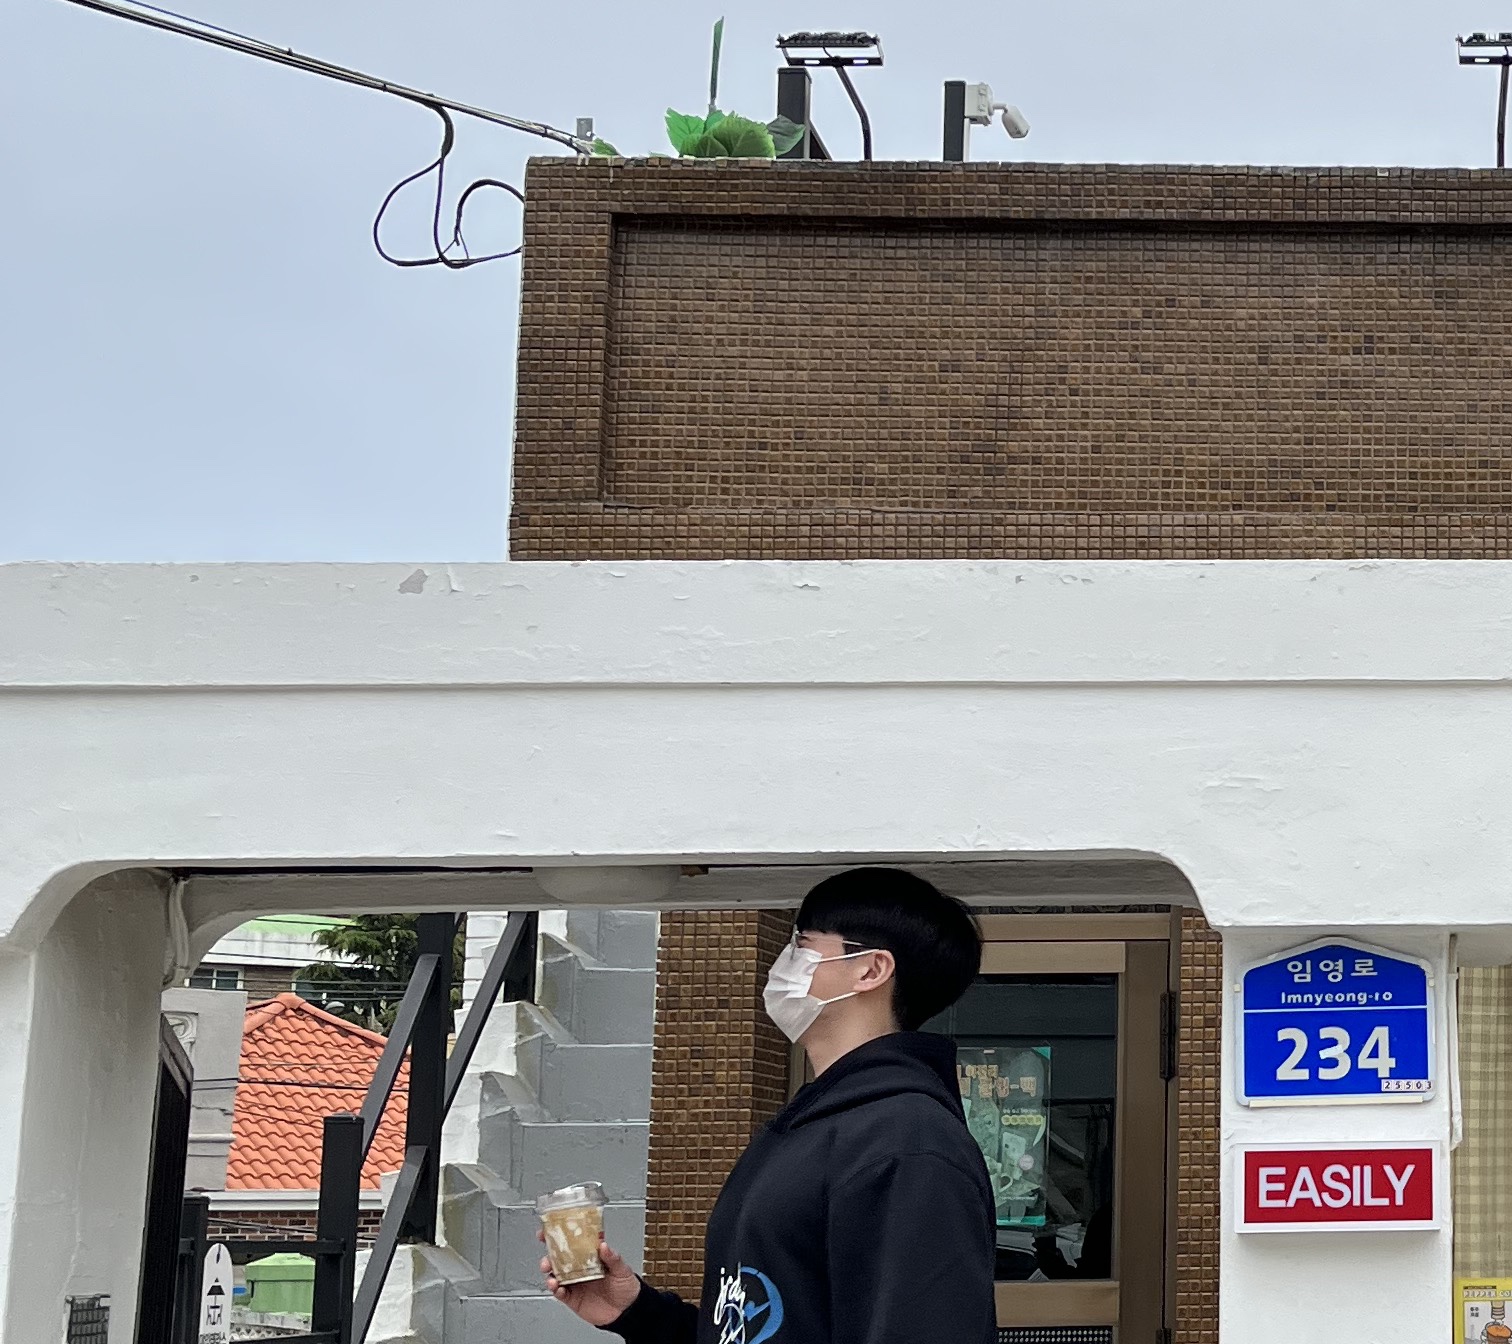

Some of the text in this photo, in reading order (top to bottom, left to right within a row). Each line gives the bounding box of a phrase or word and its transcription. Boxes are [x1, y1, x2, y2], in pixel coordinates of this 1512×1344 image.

[1287, 959, 1378, 983] 임영로
[1281, 991, 1393, 1006] Imnyeong-ro
[1276, 1025, 1396, 1081] 234
[1384, 1080, 1432, 1090] 25503
[1258, 1163, 1415, 1209] EASILY
